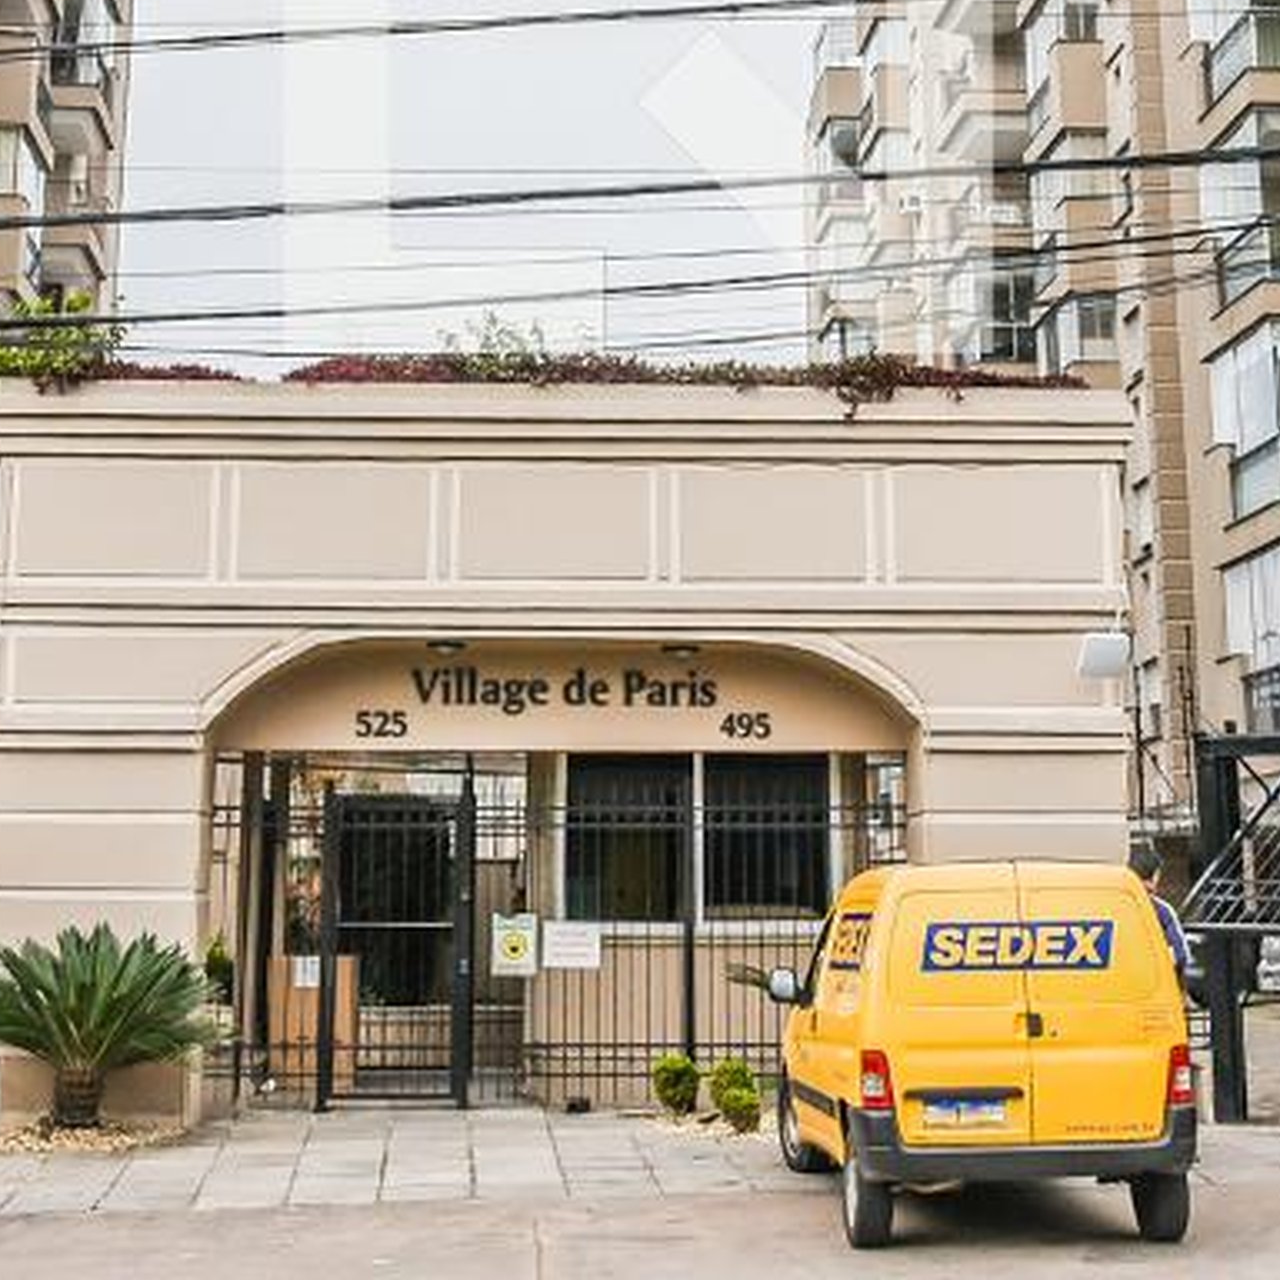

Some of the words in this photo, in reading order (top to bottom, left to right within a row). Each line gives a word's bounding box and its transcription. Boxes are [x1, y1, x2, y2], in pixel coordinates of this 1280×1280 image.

[411, 666, 550, 715] Village
[563, 667, 611, 706] de
[623, 668, 718, 707] Paris
[355, 710, 408, 738] 525
[720, 712, 772, 739] 495
[929, 926, 1105, 967] SEDEX
